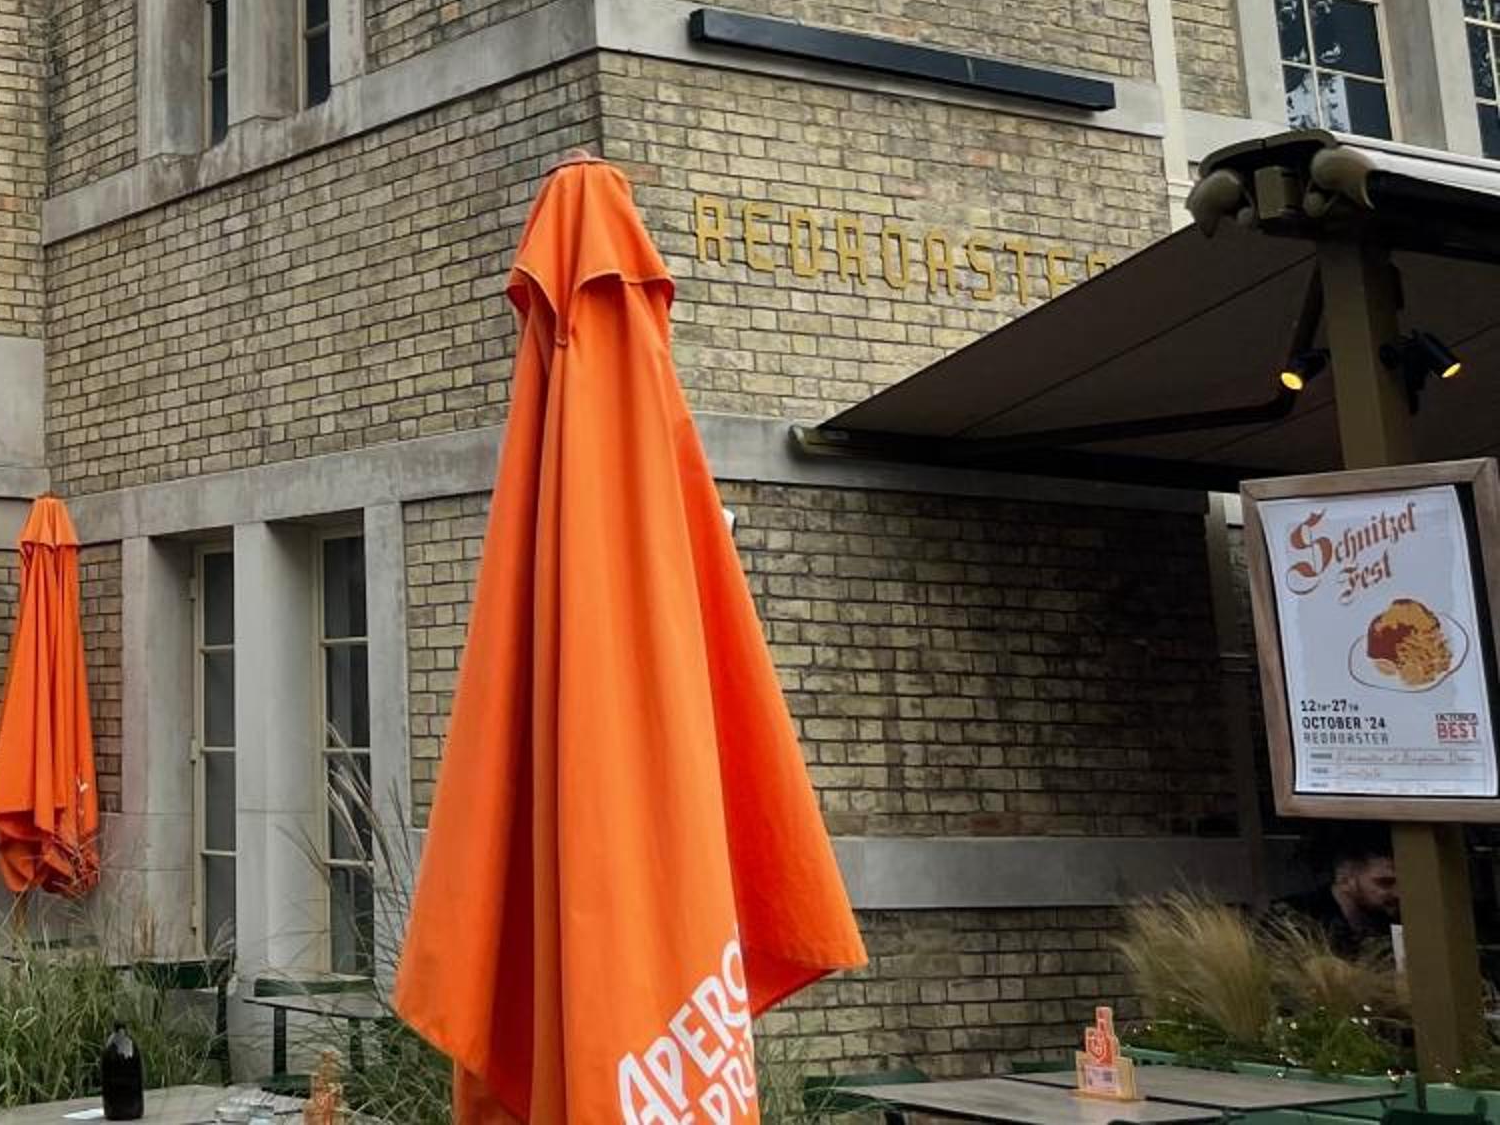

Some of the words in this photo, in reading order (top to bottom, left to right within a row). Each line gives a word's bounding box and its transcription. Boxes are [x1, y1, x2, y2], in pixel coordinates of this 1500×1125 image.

[1286, 502, 1416, 595] Schnitzel
[1337, 546, 1392, 605] Fest
[1303, 717, 1361, 730] OCTOBER
[1303, 732, 1389, 745] REDROASTER
[1438, 722, 1477, 739] BEST
[618, 938, 750, 1125] APERO
